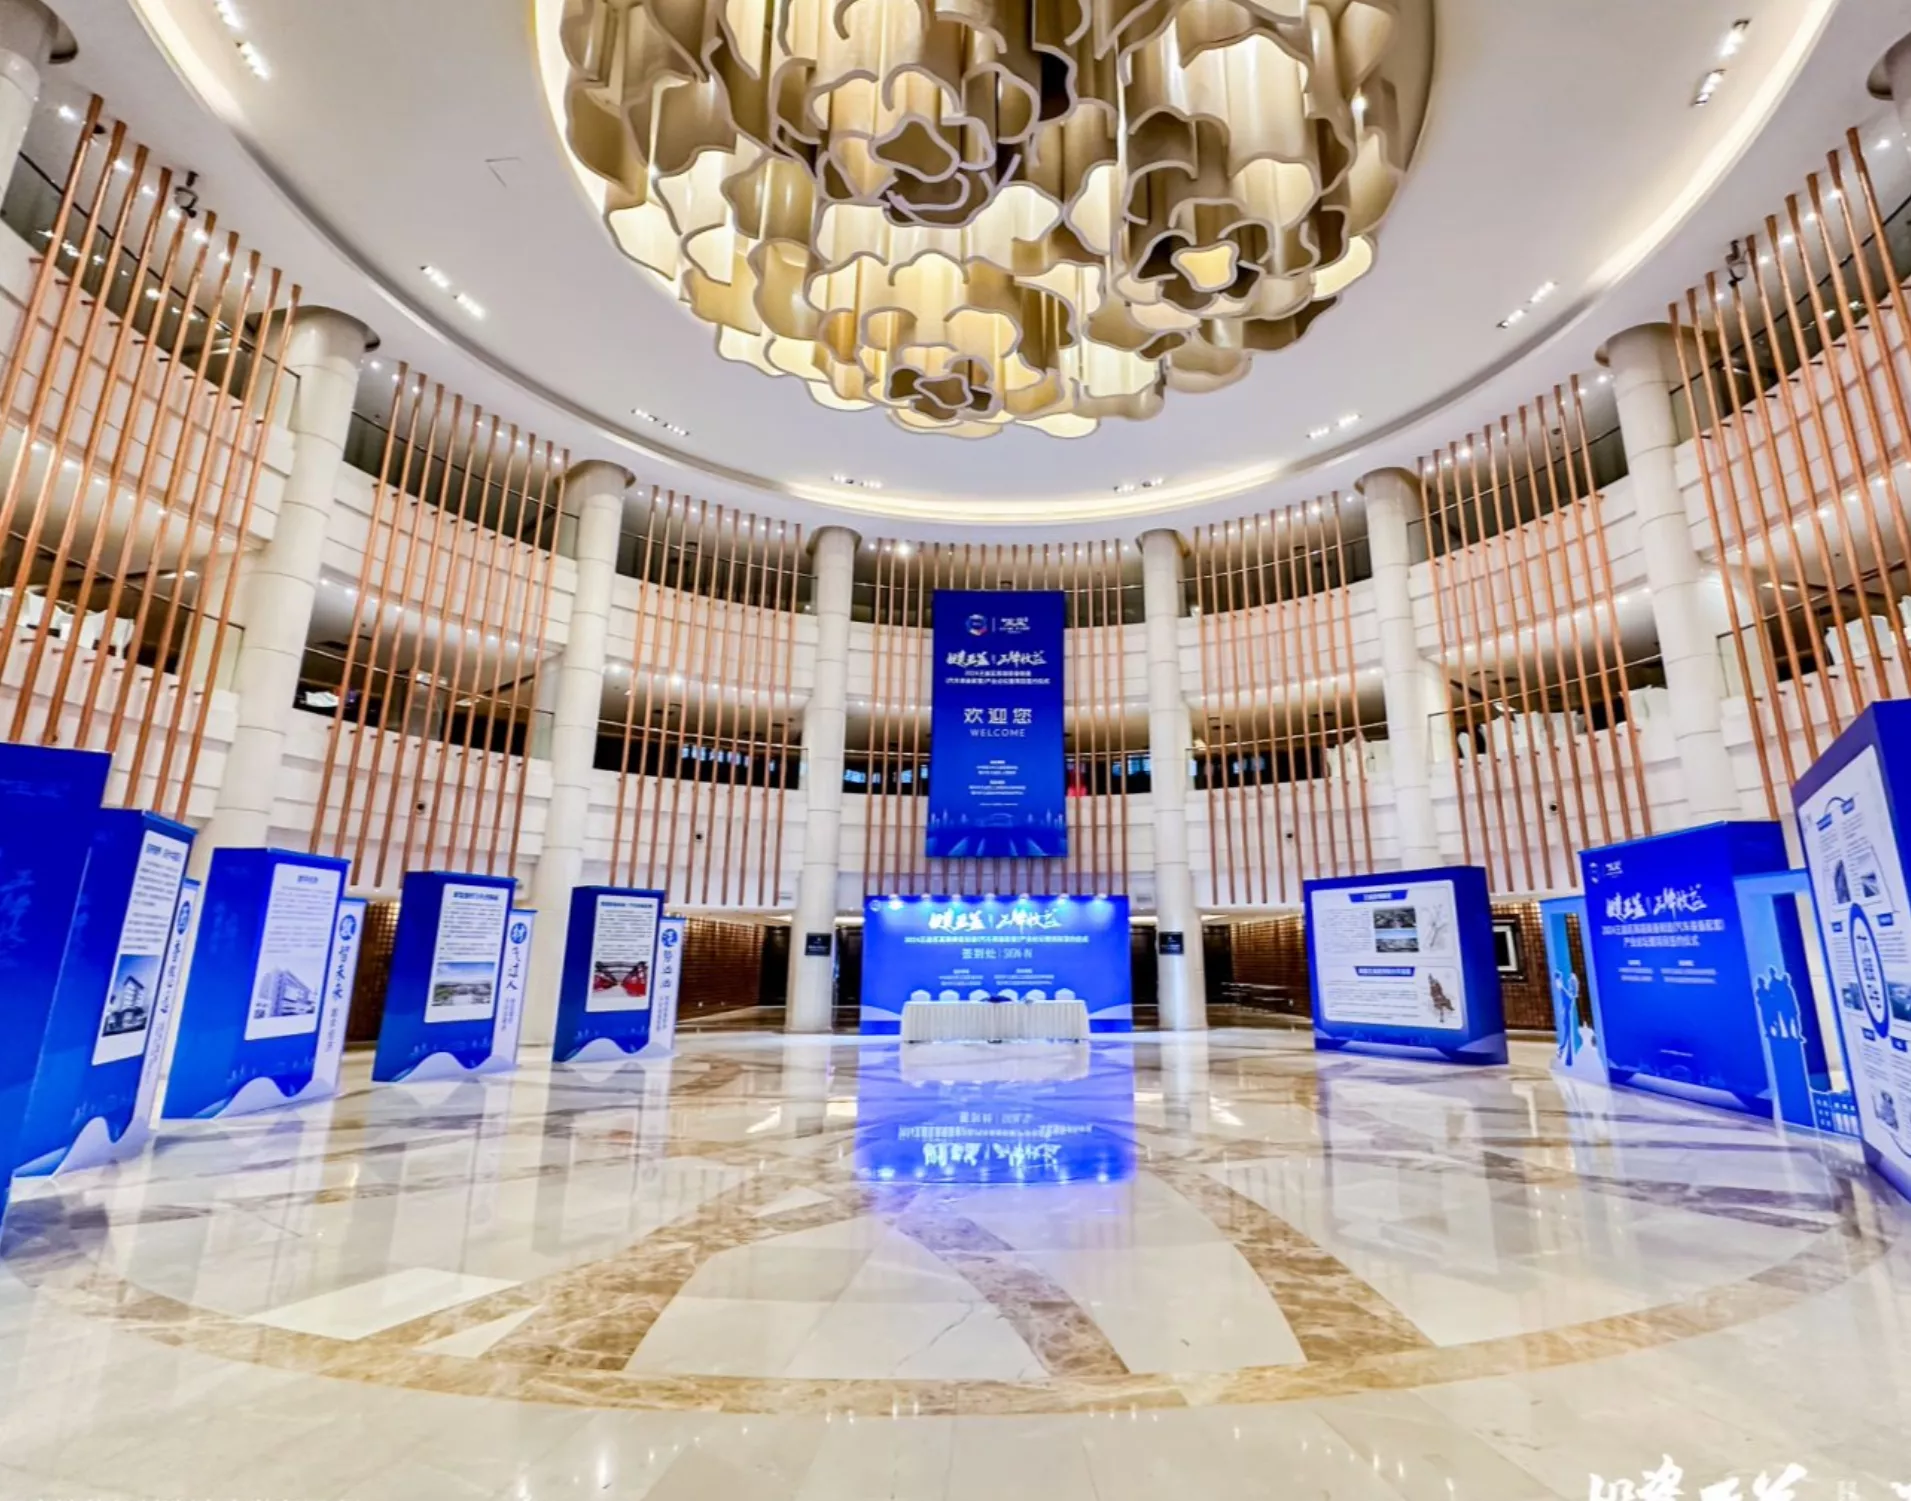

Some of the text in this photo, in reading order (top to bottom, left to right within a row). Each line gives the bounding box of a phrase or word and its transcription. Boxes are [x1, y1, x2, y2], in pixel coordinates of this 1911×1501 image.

[964, 707, 1033, 725] 欢迎您
[970, 728, 1026, 738] WELCOME
[962, 947, 997, 960] 签到处
